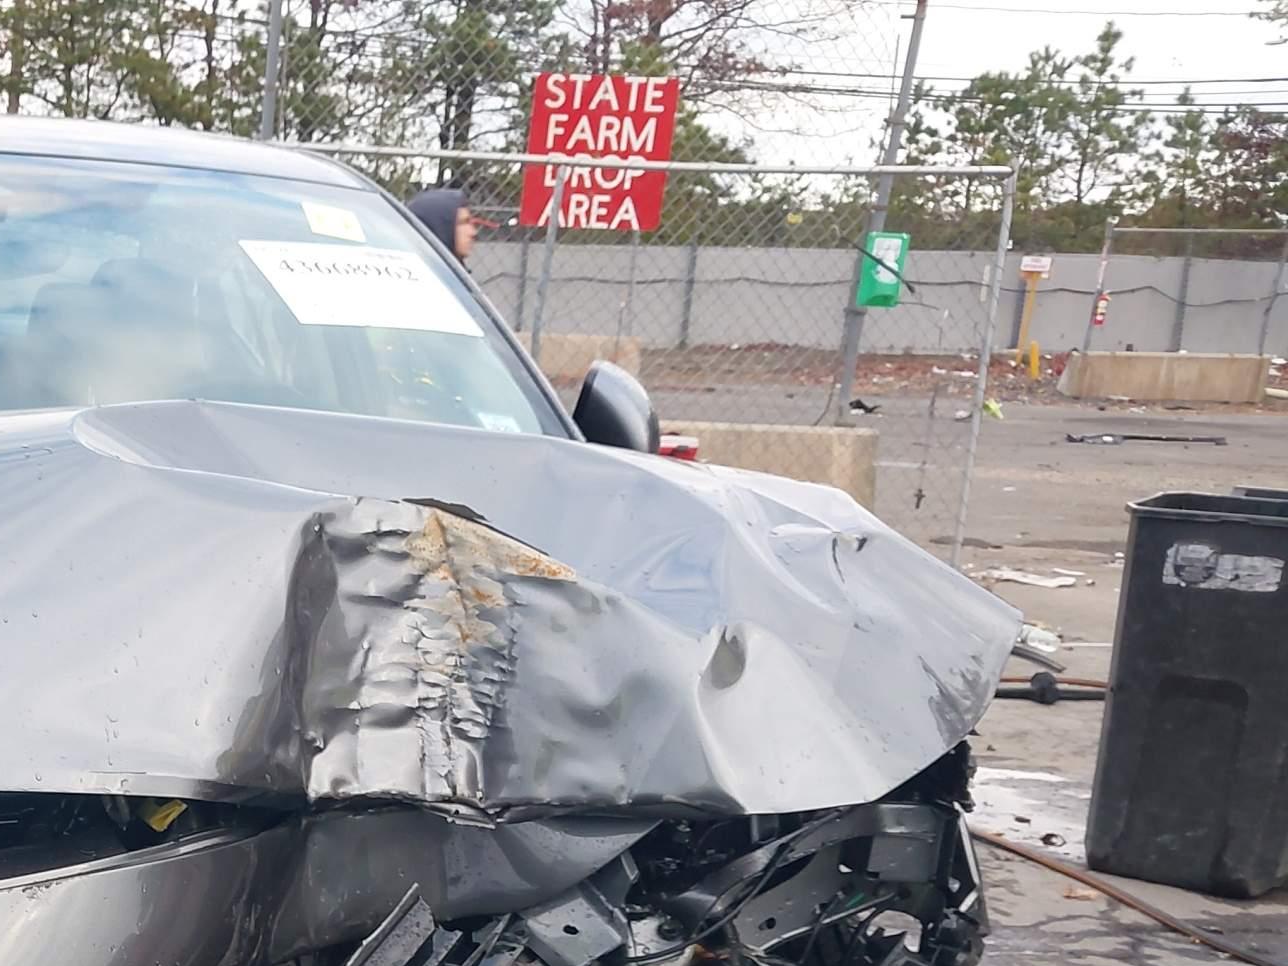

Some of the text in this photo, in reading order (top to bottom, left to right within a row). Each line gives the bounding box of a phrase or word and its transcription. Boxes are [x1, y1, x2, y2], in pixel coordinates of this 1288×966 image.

[544, 74, 668, 113] STATE
[546, 114, 657, 153] FARM
[537, 194, 640, 231] AREA
